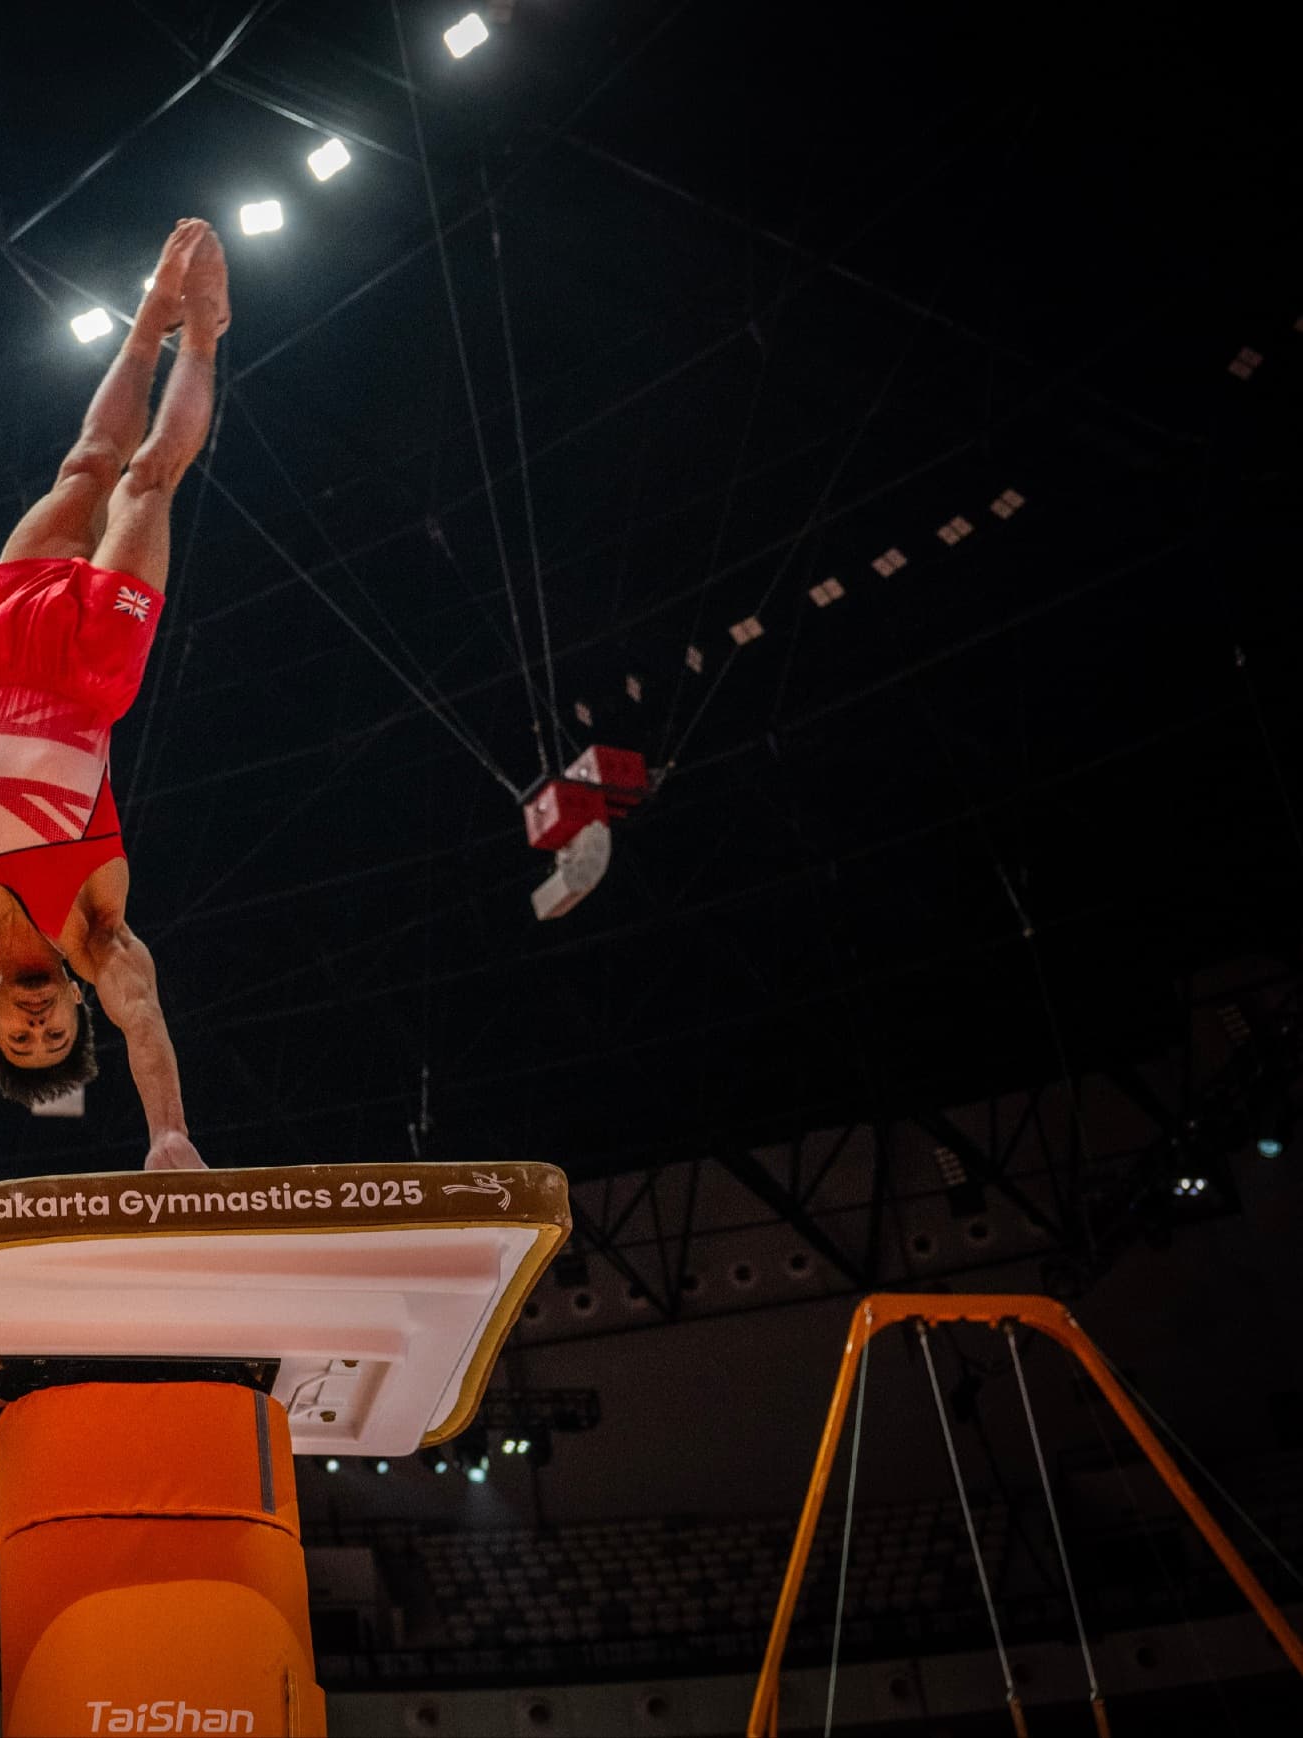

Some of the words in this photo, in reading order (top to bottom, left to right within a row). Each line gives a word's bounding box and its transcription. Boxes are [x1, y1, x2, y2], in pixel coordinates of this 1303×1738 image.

[118, 1182, 333, 1223] Gymnastics
[339, 1179, 424, 1208] 2025
[86, 1701, 255, 1733] TaiShan
